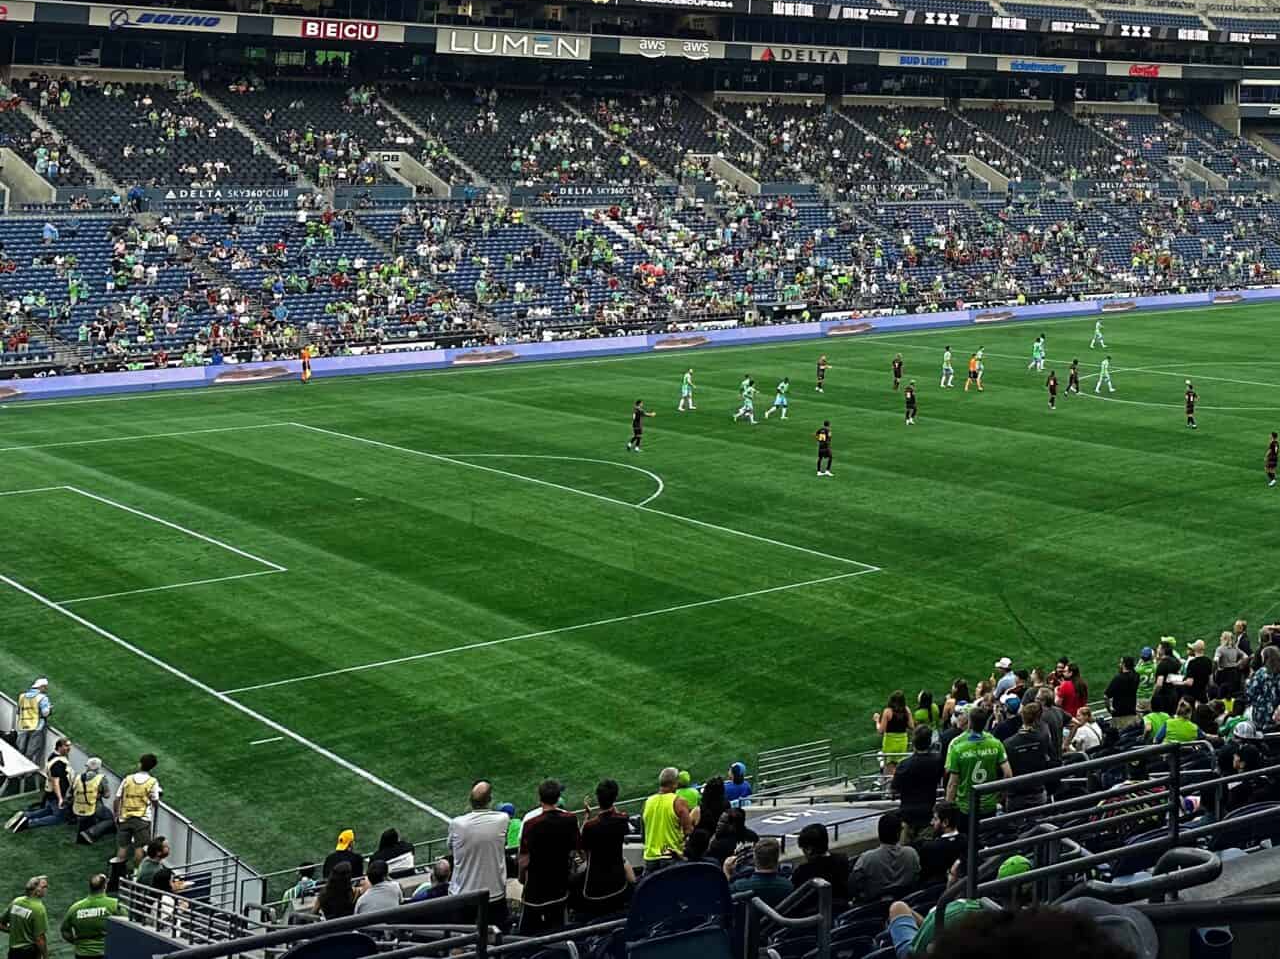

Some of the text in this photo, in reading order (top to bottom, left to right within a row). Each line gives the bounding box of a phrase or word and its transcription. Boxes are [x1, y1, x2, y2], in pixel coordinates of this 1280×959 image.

[450, 30, 581, 58] LUMEN
[640, 40, 666, 50] aws
[683, 42, 709, 52] aws
[781, 48, 840, 63] DELTA
[900, 55, 948, 67] BUD LIGHT
[180, 190, 222, 198] DELTA
[560, 186, 593, 195] DELTA
[972, 760, 987, 783] 6
